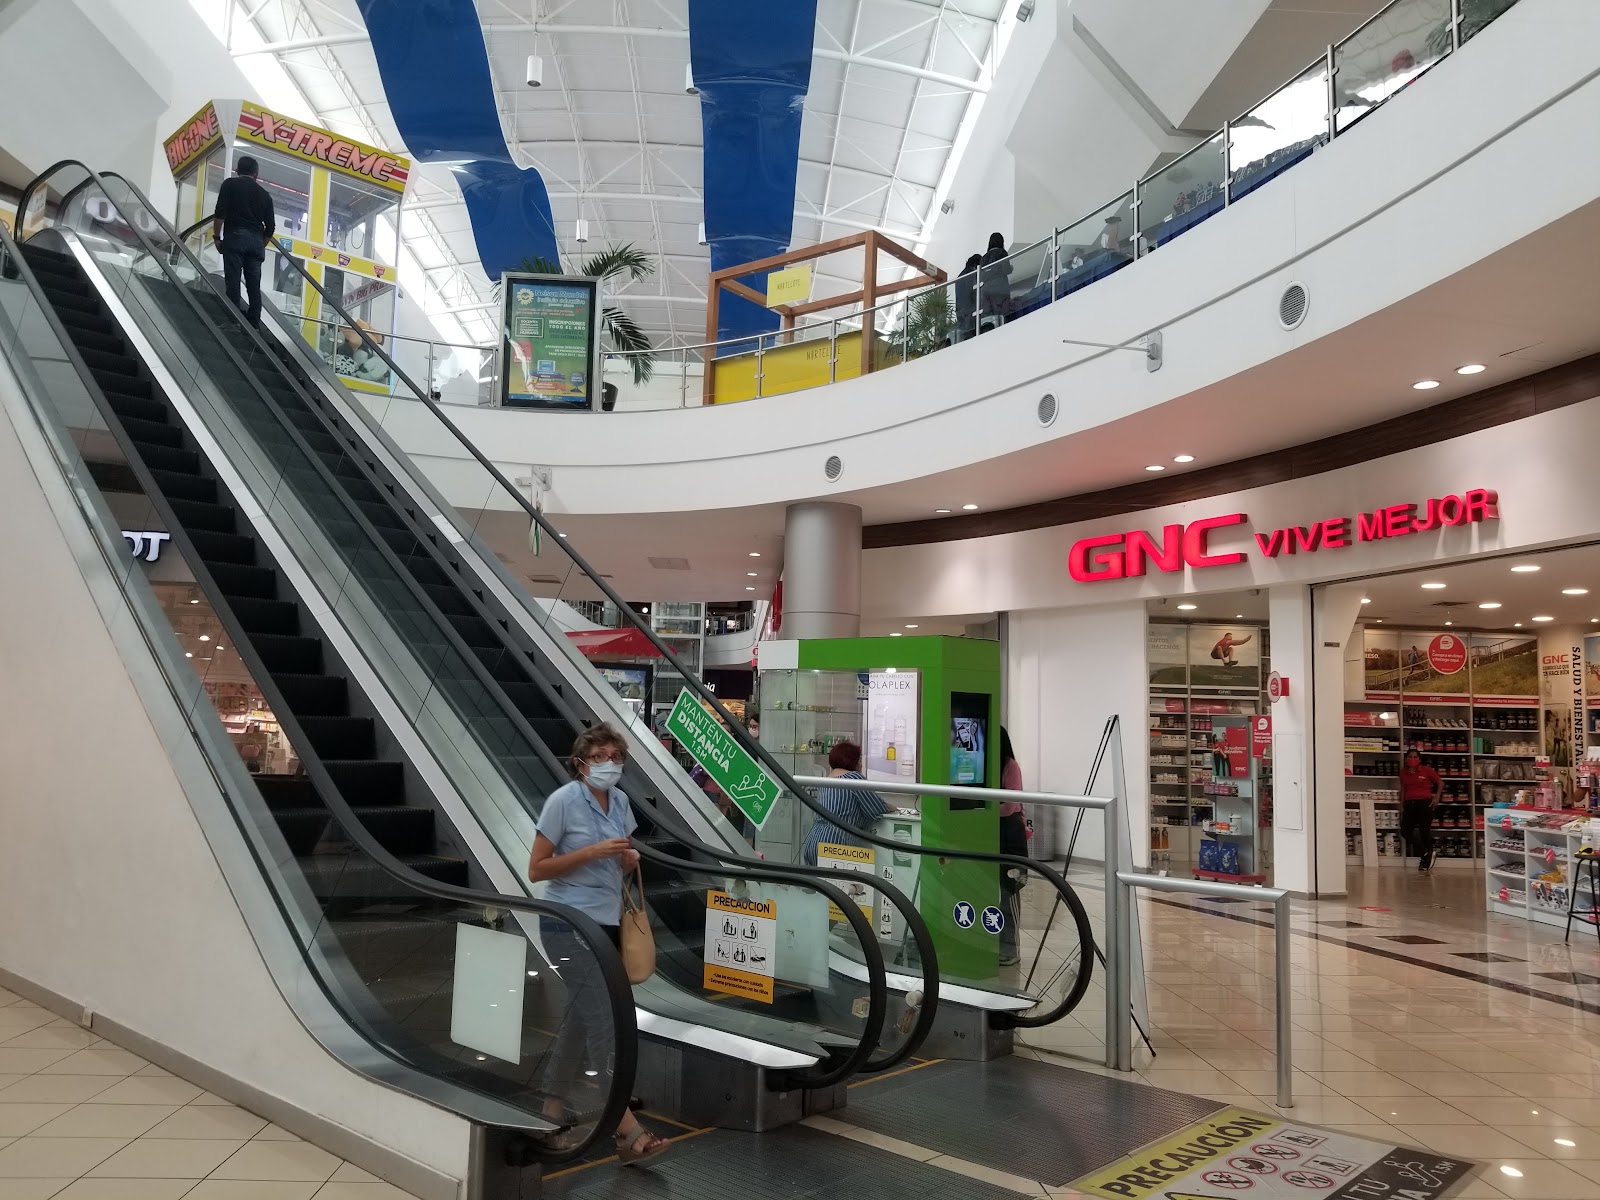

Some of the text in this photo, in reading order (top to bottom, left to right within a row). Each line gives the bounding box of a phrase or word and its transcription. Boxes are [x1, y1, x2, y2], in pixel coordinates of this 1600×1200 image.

[251, 111, 398, 183] X-TREME
[1068, 488, 1500, 583] GNC VIVE MEJOR
[1542, 654, 1569, 665] GNC
[1572, 646, 1581, 686] SALUD
[1573, 688, 1582, 696] Y
[677, 710, 730, 774] DISTANCIA
[681, 697, 737, 759] MANTÉN TU
[691, 740, 708, 761] 1.5M
[823, 846, 870, 860] PRECAUCIÓN
[1099, 1116, 1273, 1198] PRECAUCIÓN
[1349, 1178, 1390, 1196] TU
